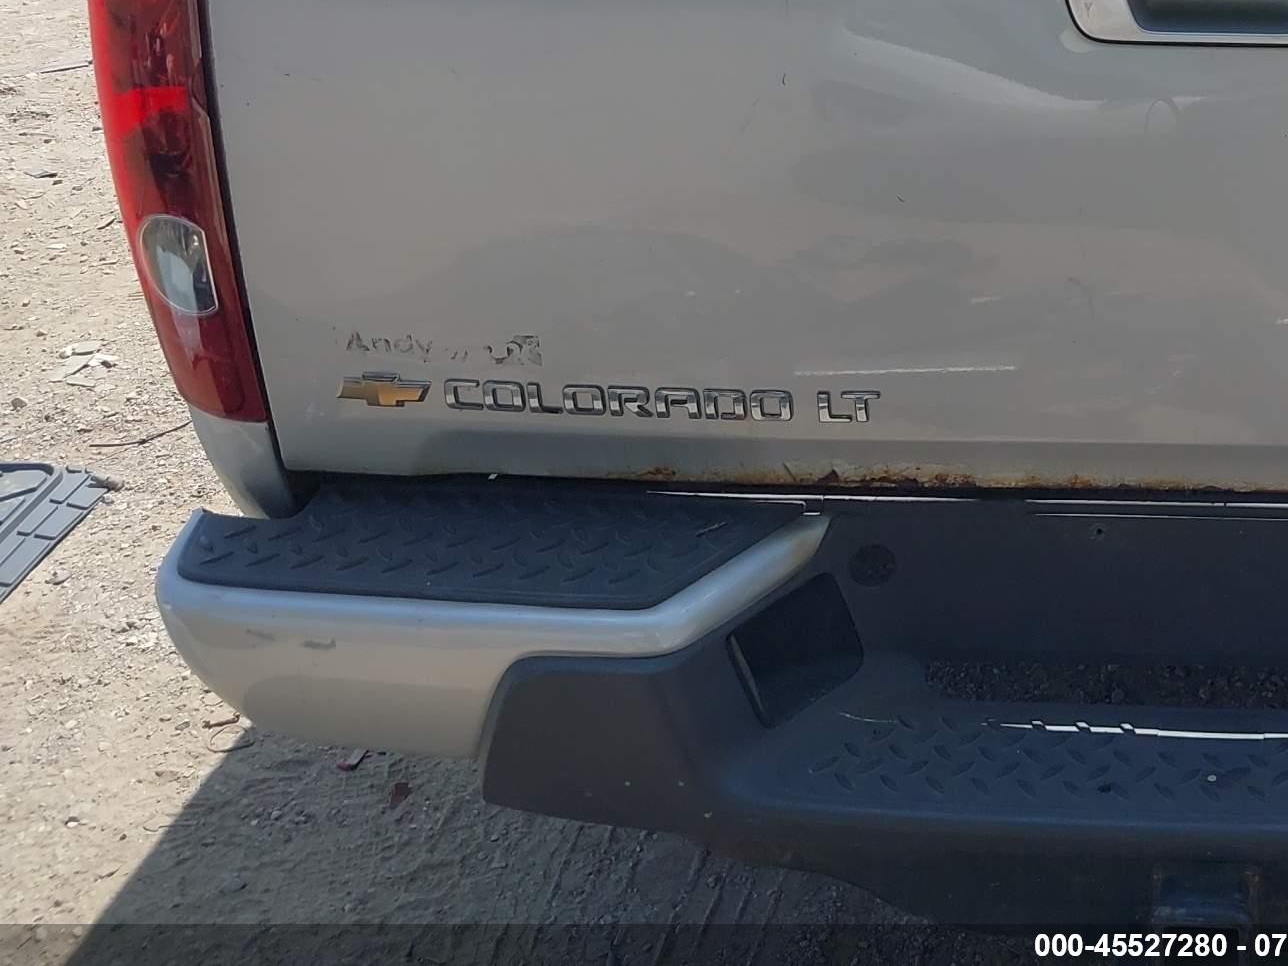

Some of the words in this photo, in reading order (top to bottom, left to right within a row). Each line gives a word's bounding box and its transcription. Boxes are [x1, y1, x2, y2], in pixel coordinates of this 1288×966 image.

[345, 332, 433, 363] Andy
[443, 377, 795, 423] COLORADO
[816, 390, 881, 424] LT
